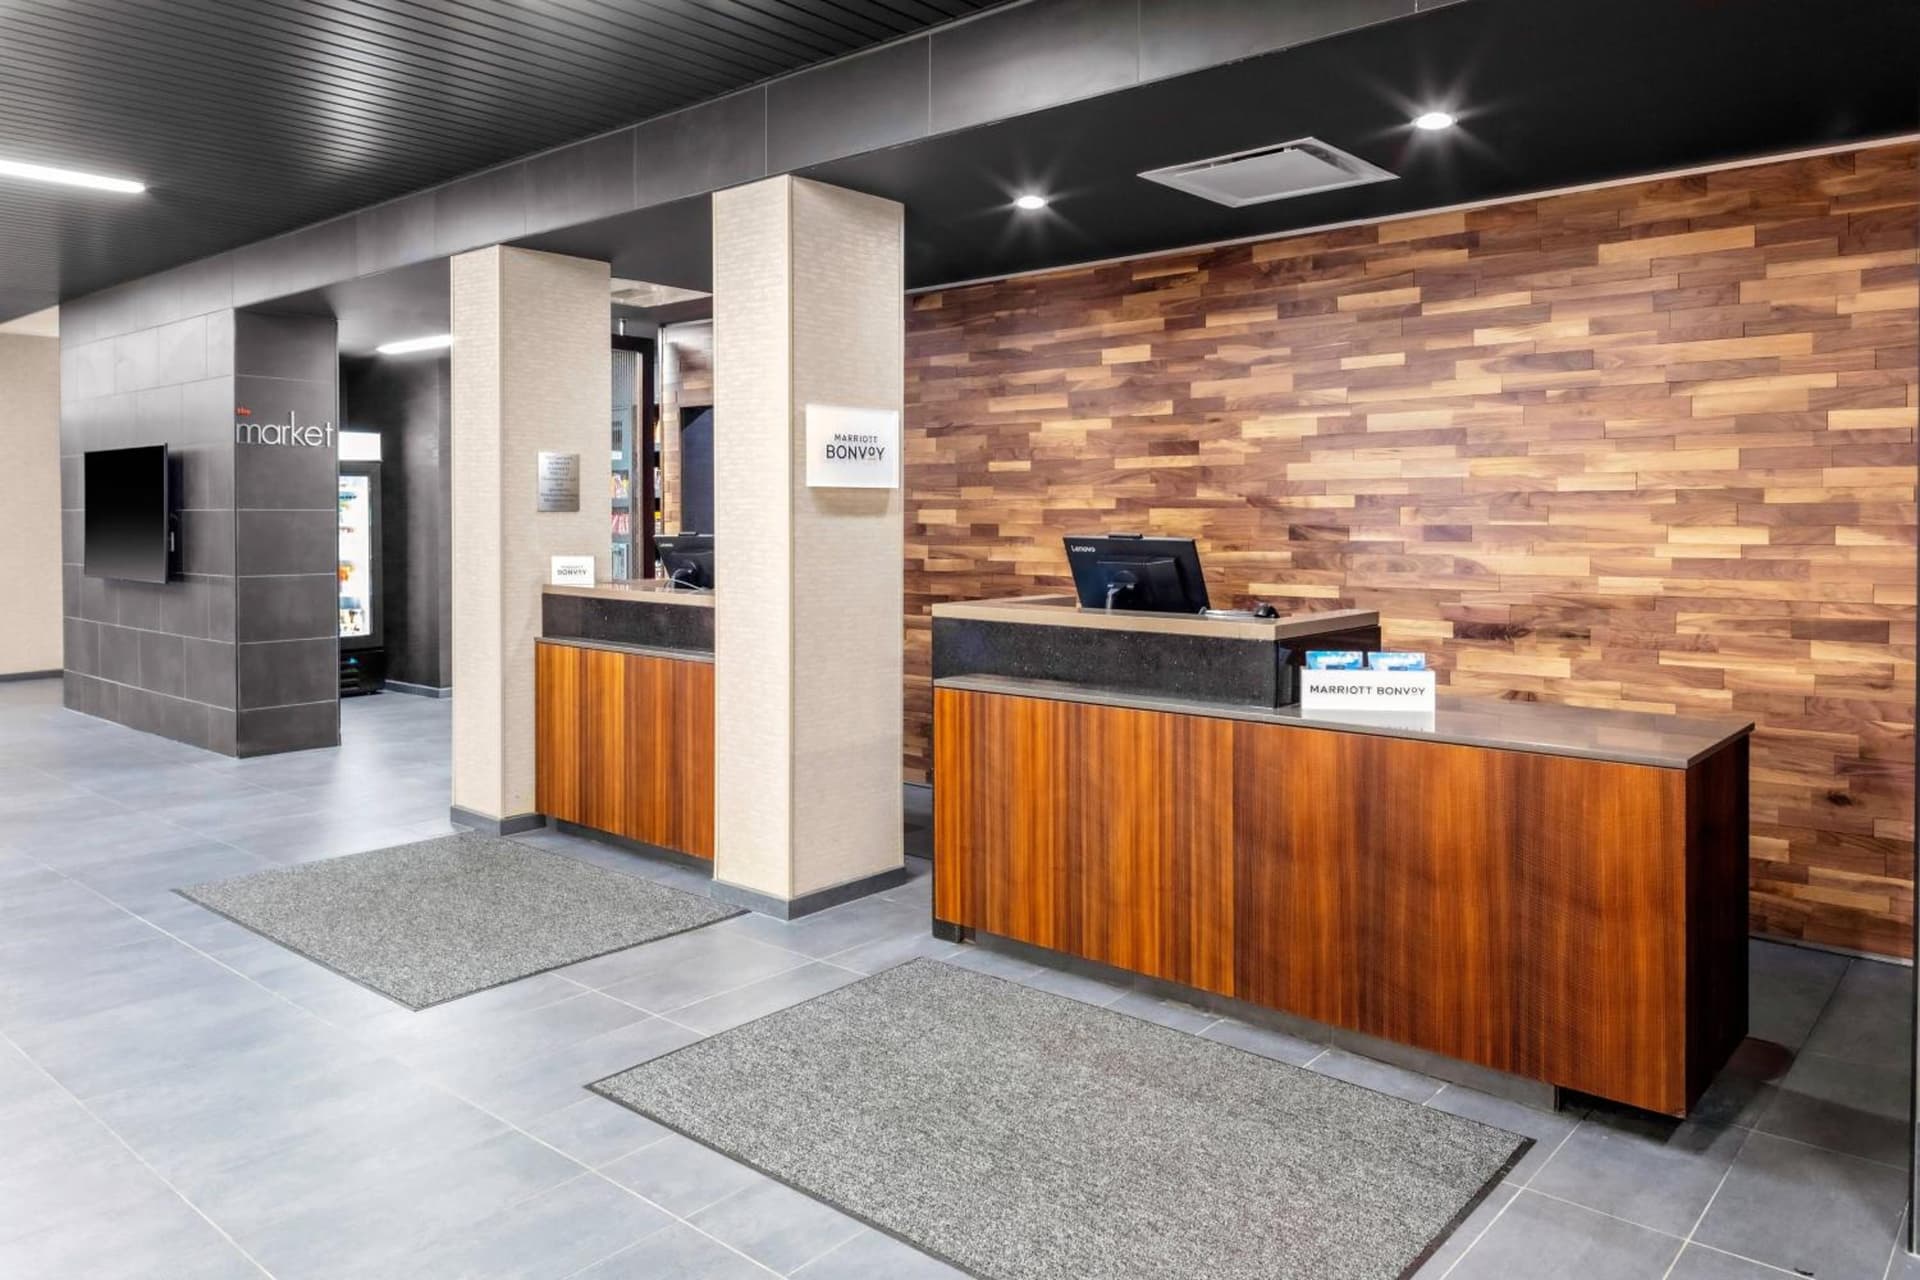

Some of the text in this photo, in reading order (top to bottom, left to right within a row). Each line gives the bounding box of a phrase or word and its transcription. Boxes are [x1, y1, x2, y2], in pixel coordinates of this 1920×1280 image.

[236, 410, 334, 447] market
[834, 433, 878, 443] MARRIOTT
[826, 444, 886, 461] BONVOY
[1310, 684, 1426, 696] MARRIOTT BONVOY
